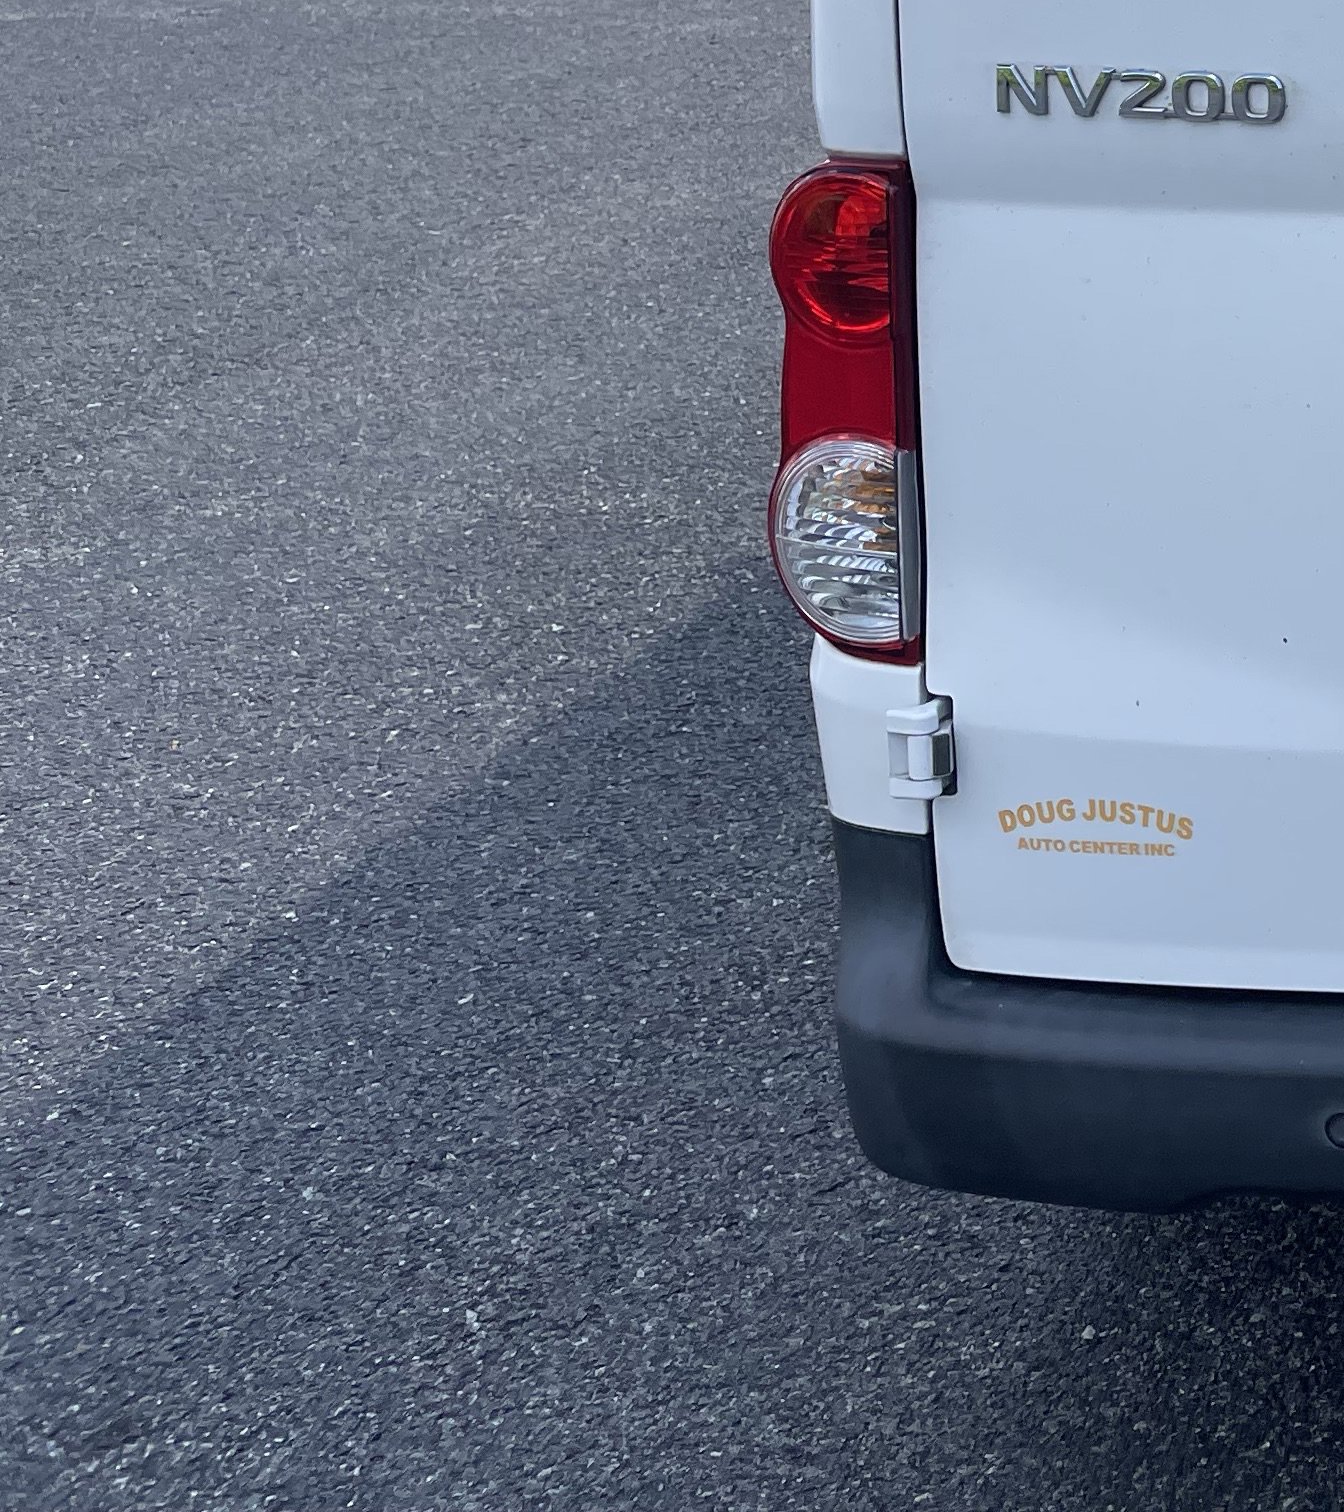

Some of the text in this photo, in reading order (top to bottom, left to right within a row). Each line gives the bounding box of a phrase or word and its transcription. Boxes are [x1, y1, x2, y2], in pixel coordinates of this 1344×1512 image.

[996, 63, 1287, 123] NV200
[998, 798, 1194, 840] DOUG JUSTUS
[1017, 837, 1176, 857] AUTO CENTER INC
